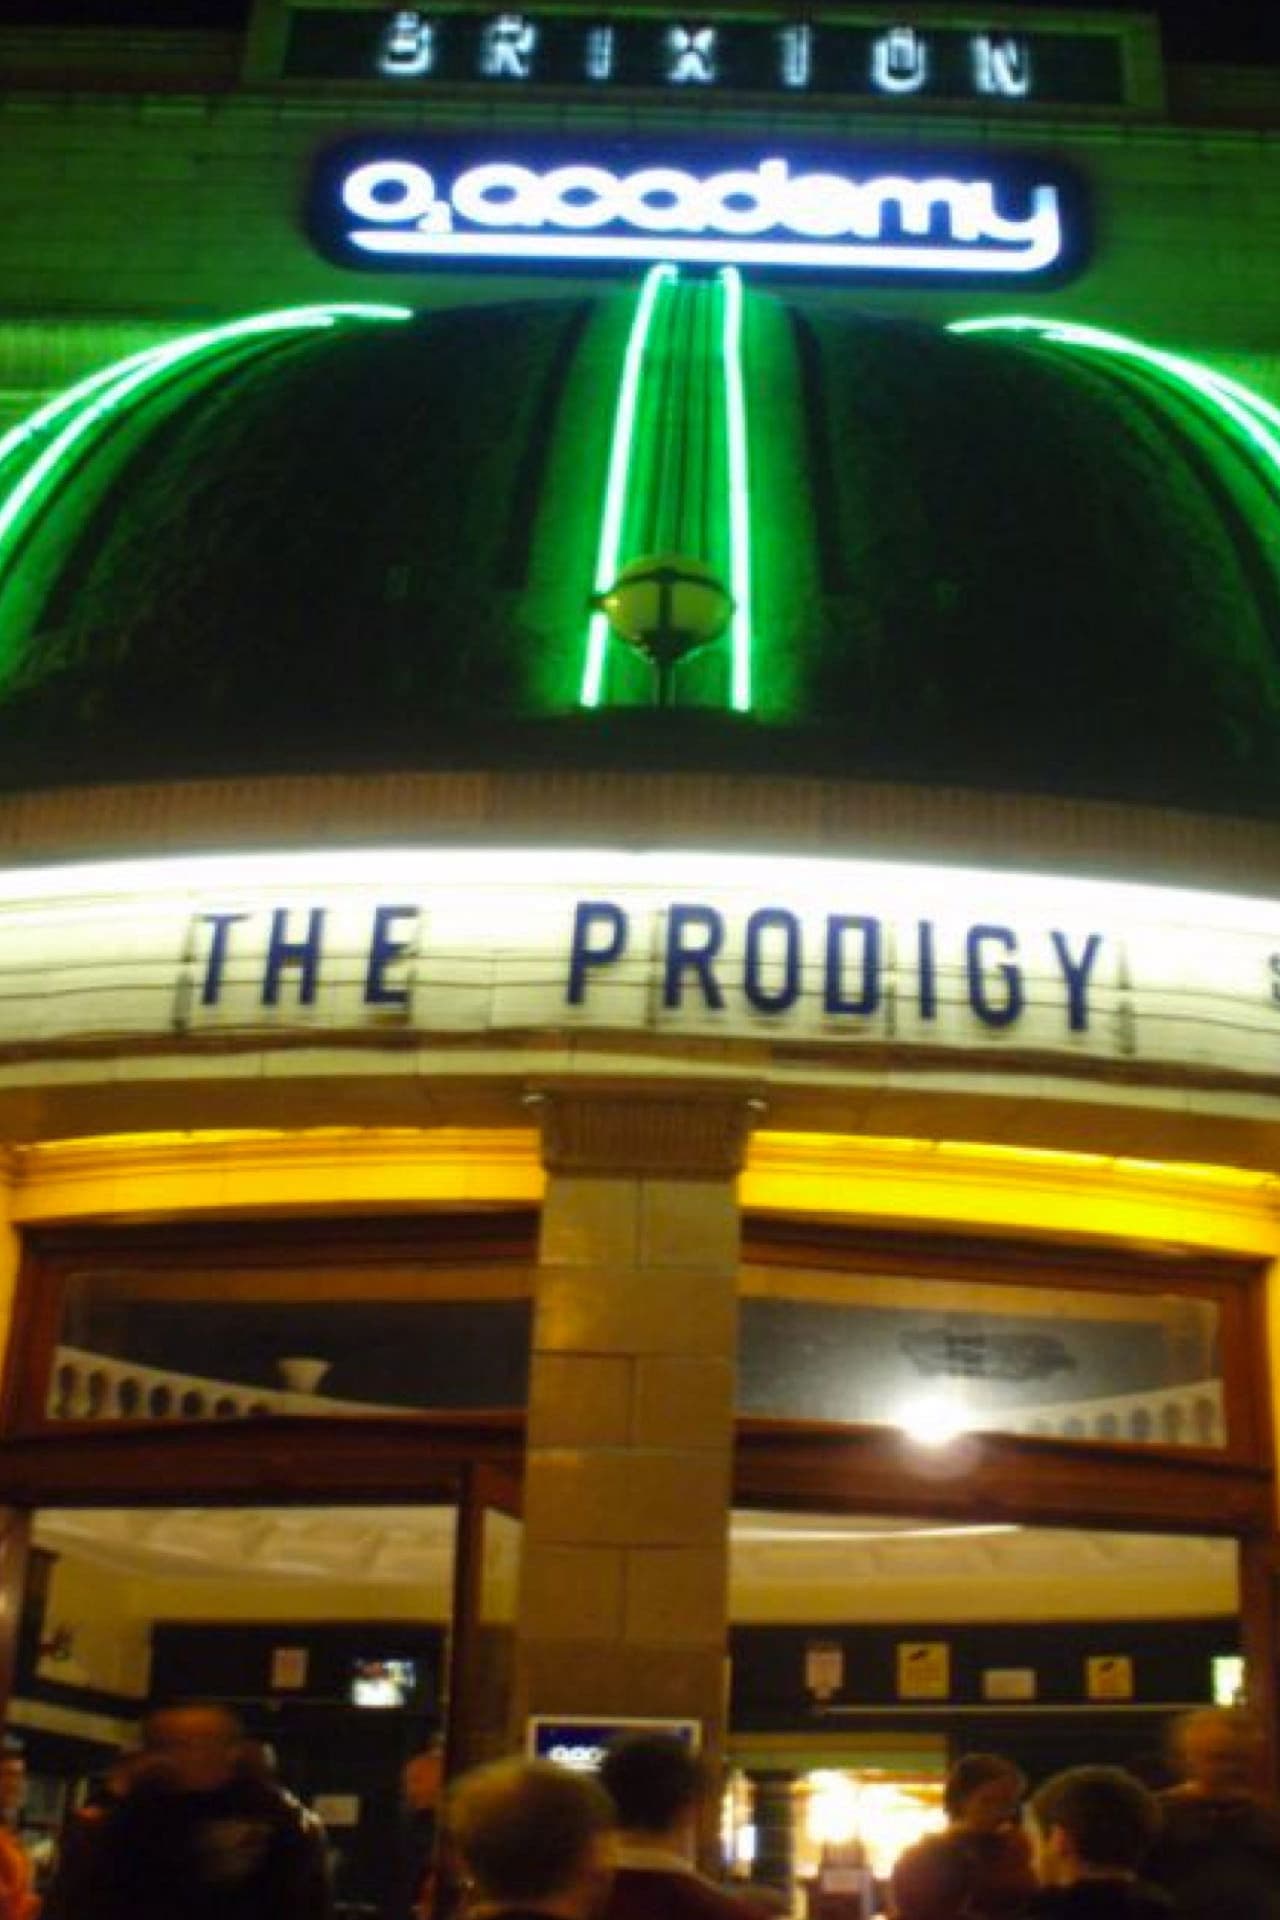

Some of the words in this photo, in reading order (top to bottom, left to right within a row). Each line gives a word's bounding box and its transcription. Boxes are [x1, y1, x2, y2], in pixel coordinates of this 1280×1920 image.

[378, 10, 1030, 97] BRIXTON
[200, 903, 419, 1008] THE
[565, 900, 1103, 1034] PRODIGY
